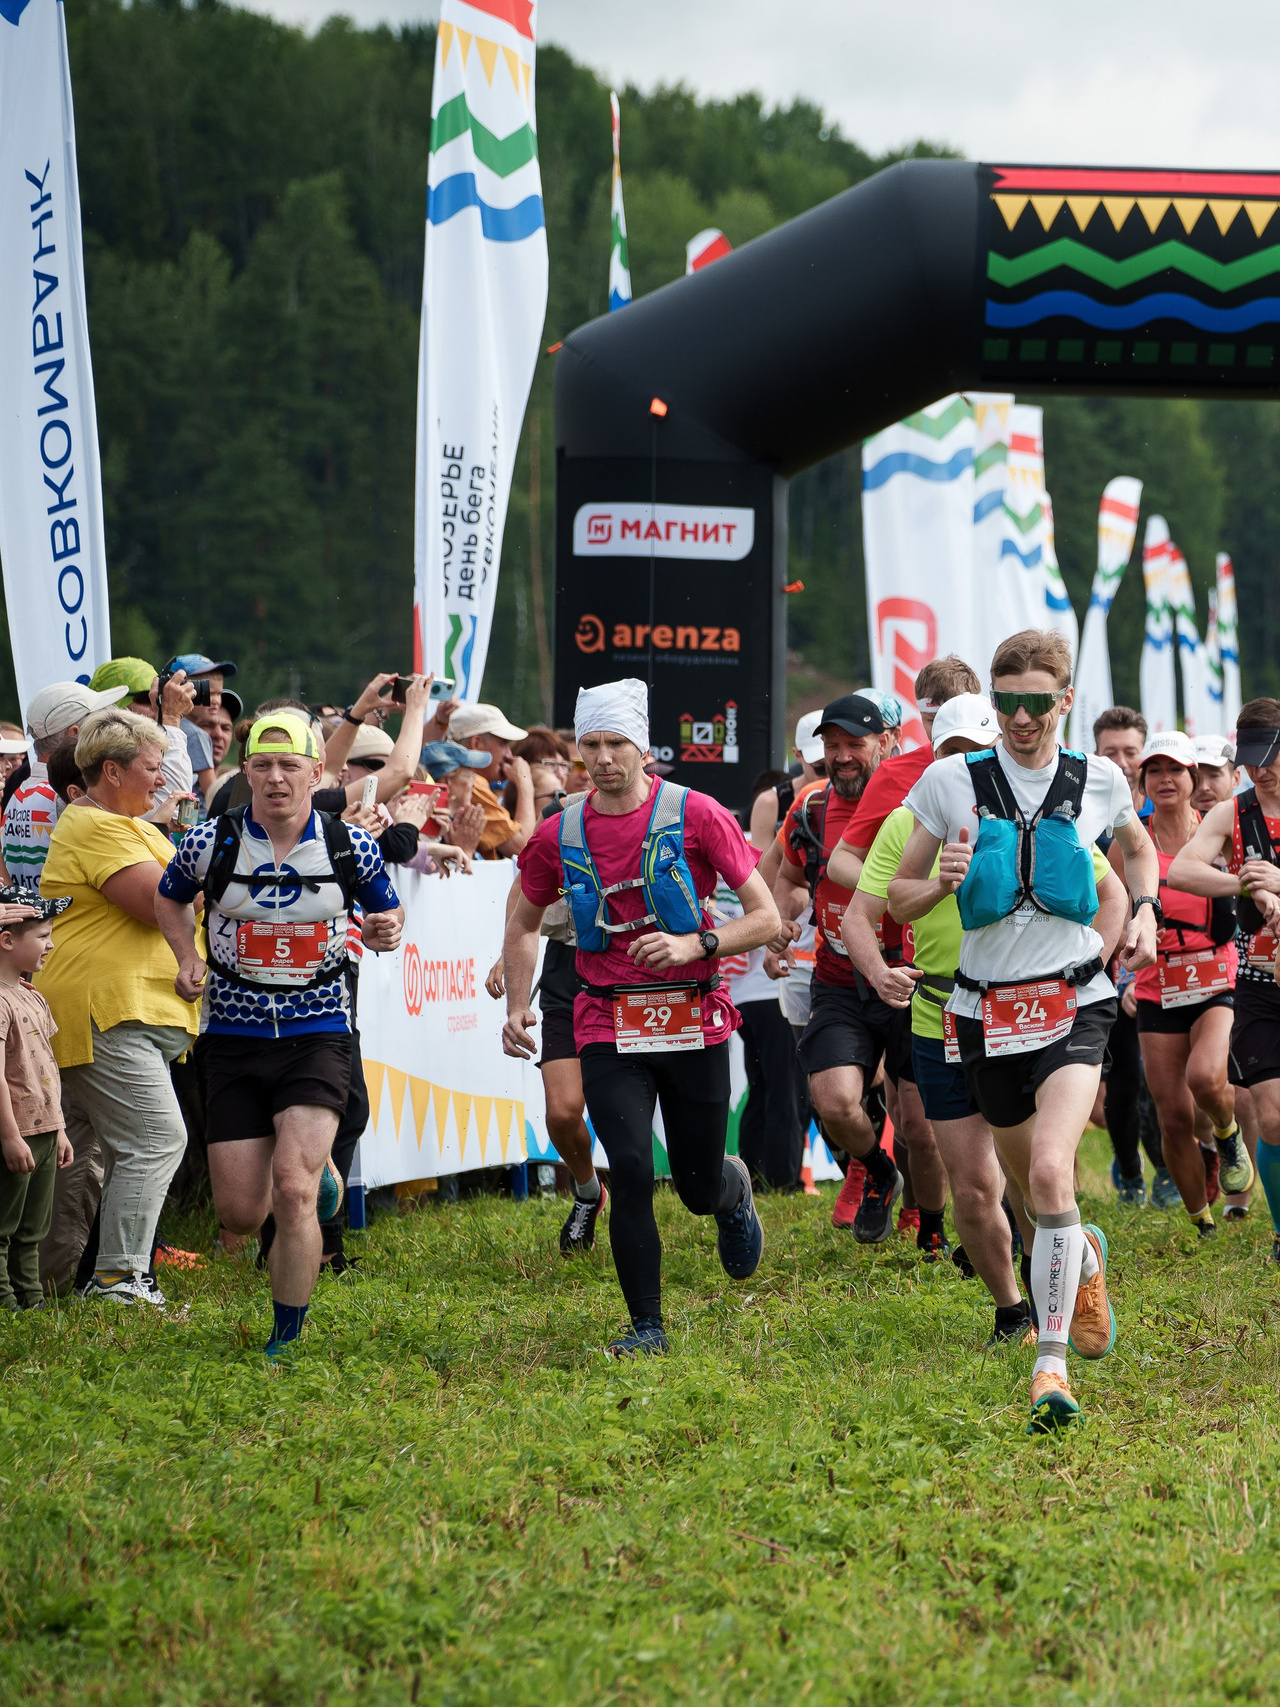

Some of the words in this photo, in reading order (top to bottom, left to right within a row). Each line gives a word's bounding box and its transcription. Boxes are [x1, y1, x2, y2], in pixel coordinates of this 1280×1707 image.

[460, 465, 485, 525] бега
[620, 519, 738, 545] МАГНИТ
[457, 533, 479, 601] день
[611, 623, 741, 652] arenza
[1149, 739, 1179, 750] RUSSIA
[1034, 915, 1050, 923] 2018
[274, 937, 291, 958] 5
[423, 958, 476, 1003] СОГЛАСИЕ
[1185, 965, 1199, 983] 2
[642, 1006, 672, 1028] 29
[1013, 1000, 1048, 1024] 24
[1018, 1022, 1045, 1030] Василий
